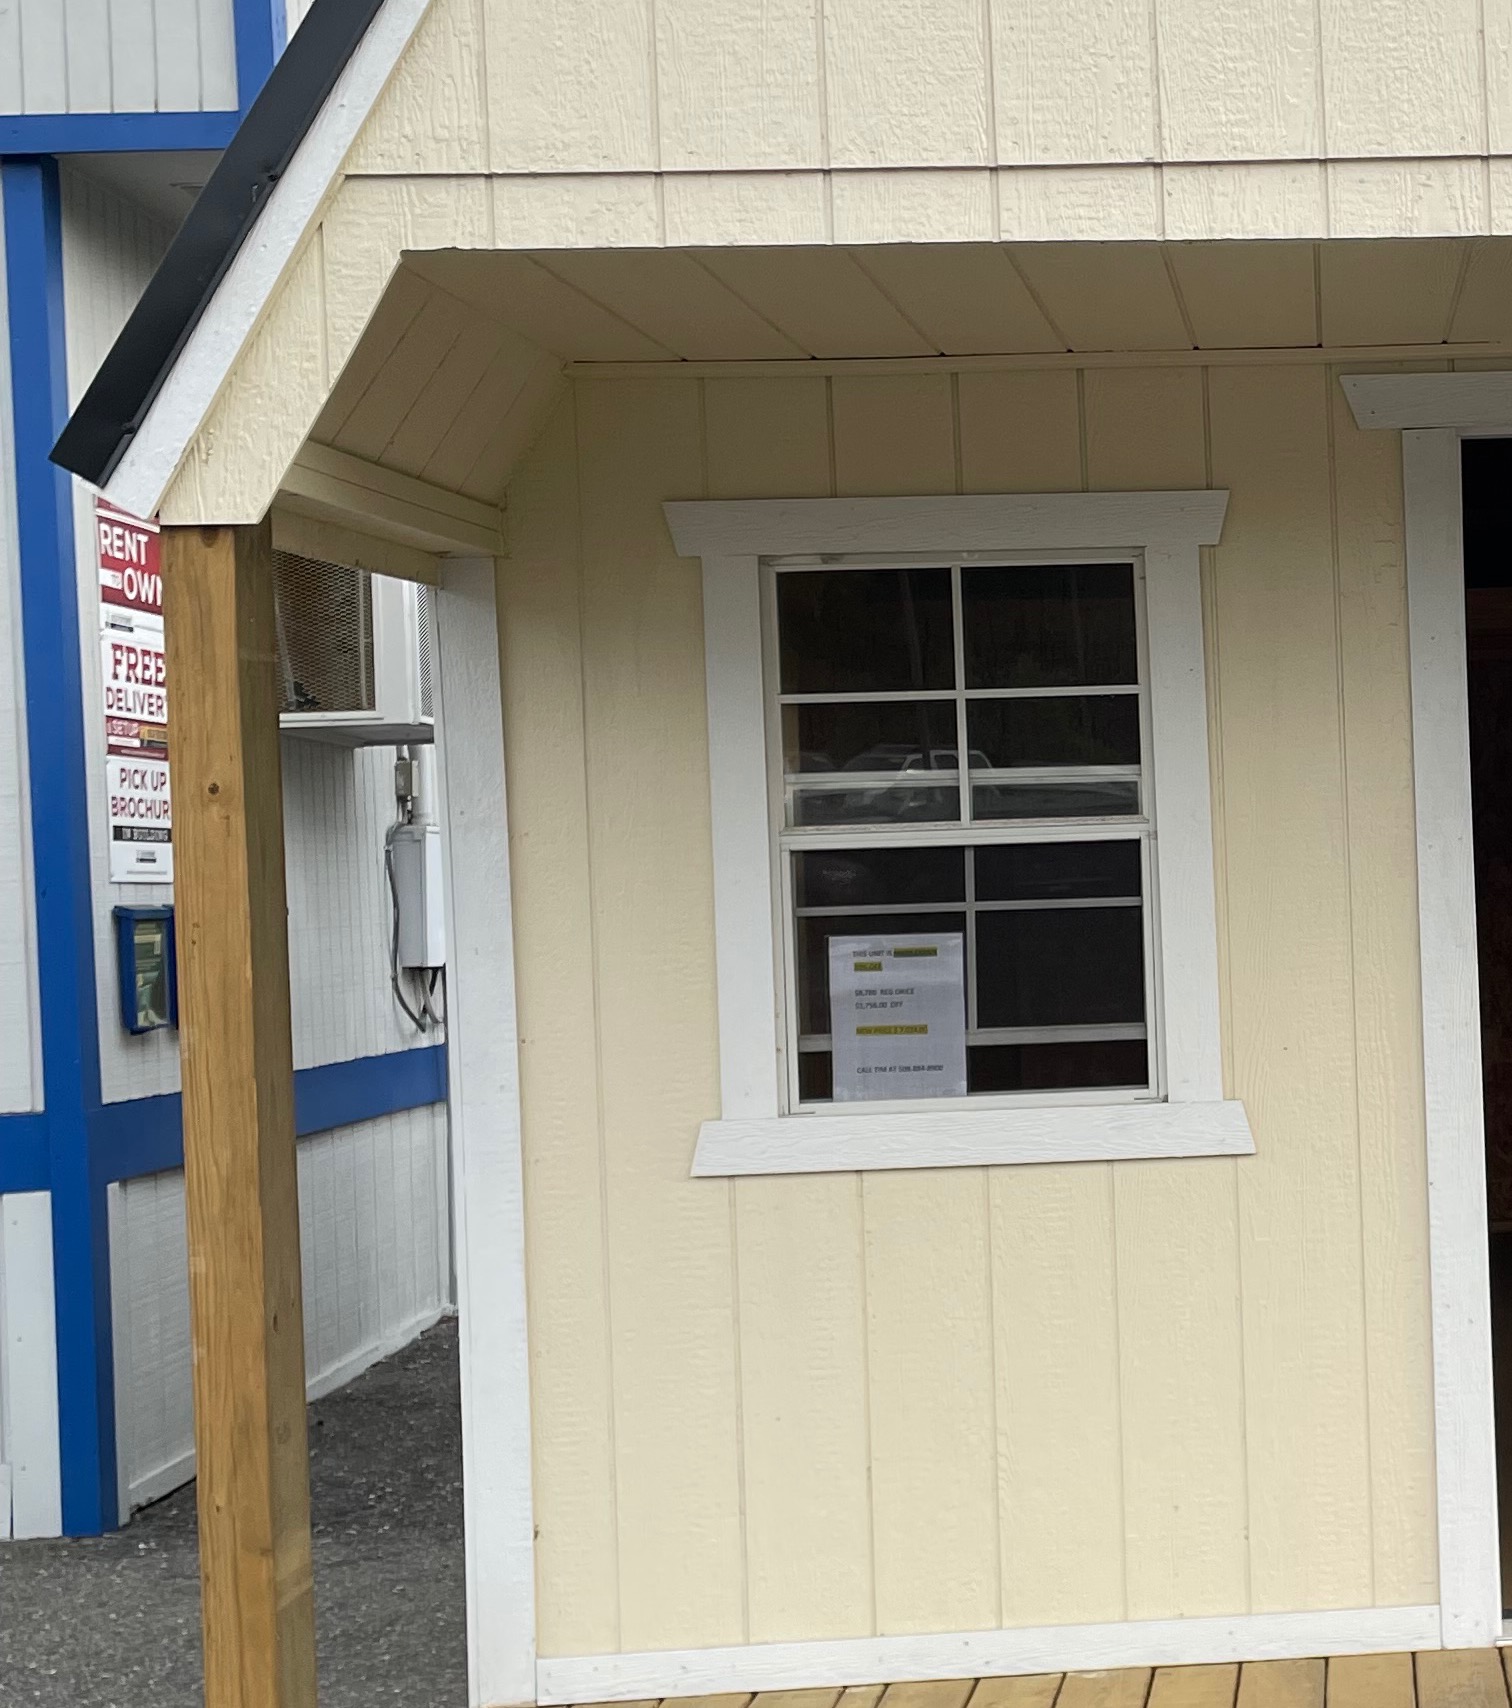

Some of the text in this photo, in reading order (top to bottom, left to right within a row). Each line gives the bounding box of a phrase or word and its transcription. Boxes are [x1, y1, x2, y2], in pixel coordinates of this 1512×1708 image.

[100, 523, 149, 565] RENT
[111, 643, 166, 687] FREE
[106, 687, 167, 718] DELIVER
[119, 767, 167, 791] PICK UP
[111, 796, 170, 820] BROCHUR
[852, 950, 867, 958] THIS
[856, 1066, 872, 1074] CALL
